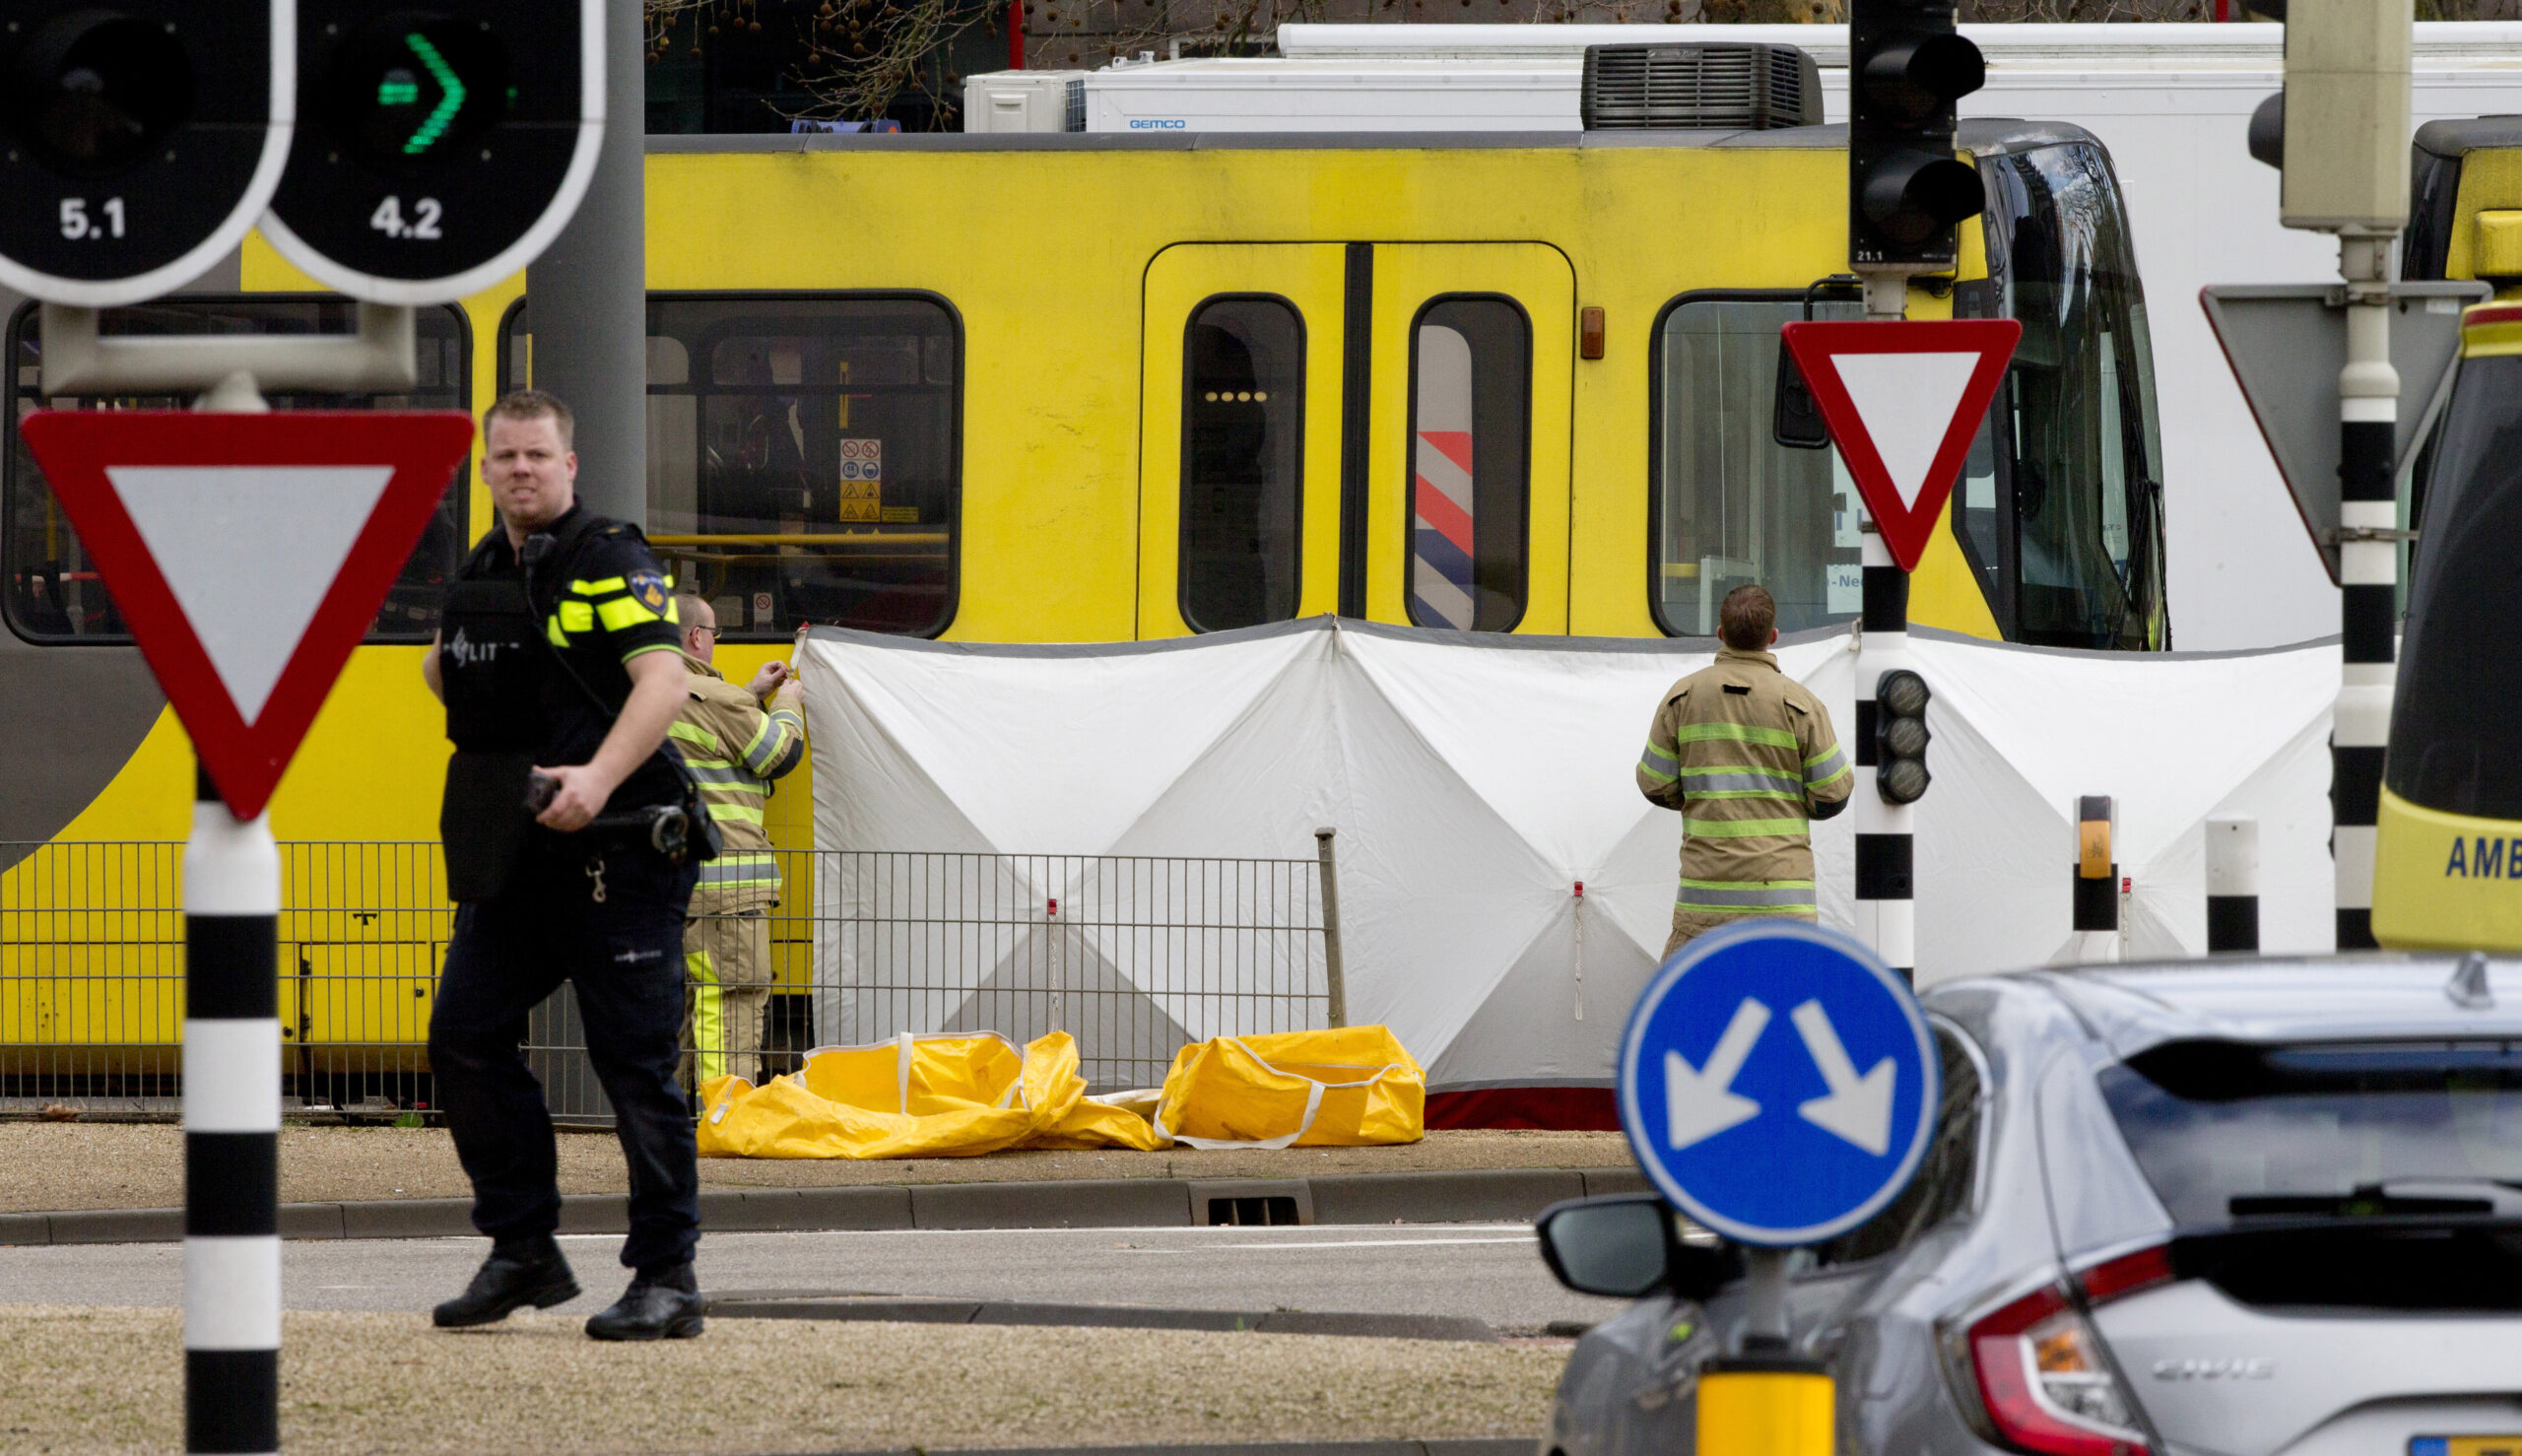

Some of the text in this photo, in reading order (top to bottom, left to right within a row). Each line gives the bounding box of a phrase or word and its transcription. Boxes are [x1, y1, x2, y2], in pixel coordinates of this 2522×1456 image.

[1130, 119, 1186, 129] GEMCO
[60, 197, 125, 239] 5.1
[370, 196, 442, 239] 4.2
[1857, 250, 1883, 261] 21.1
